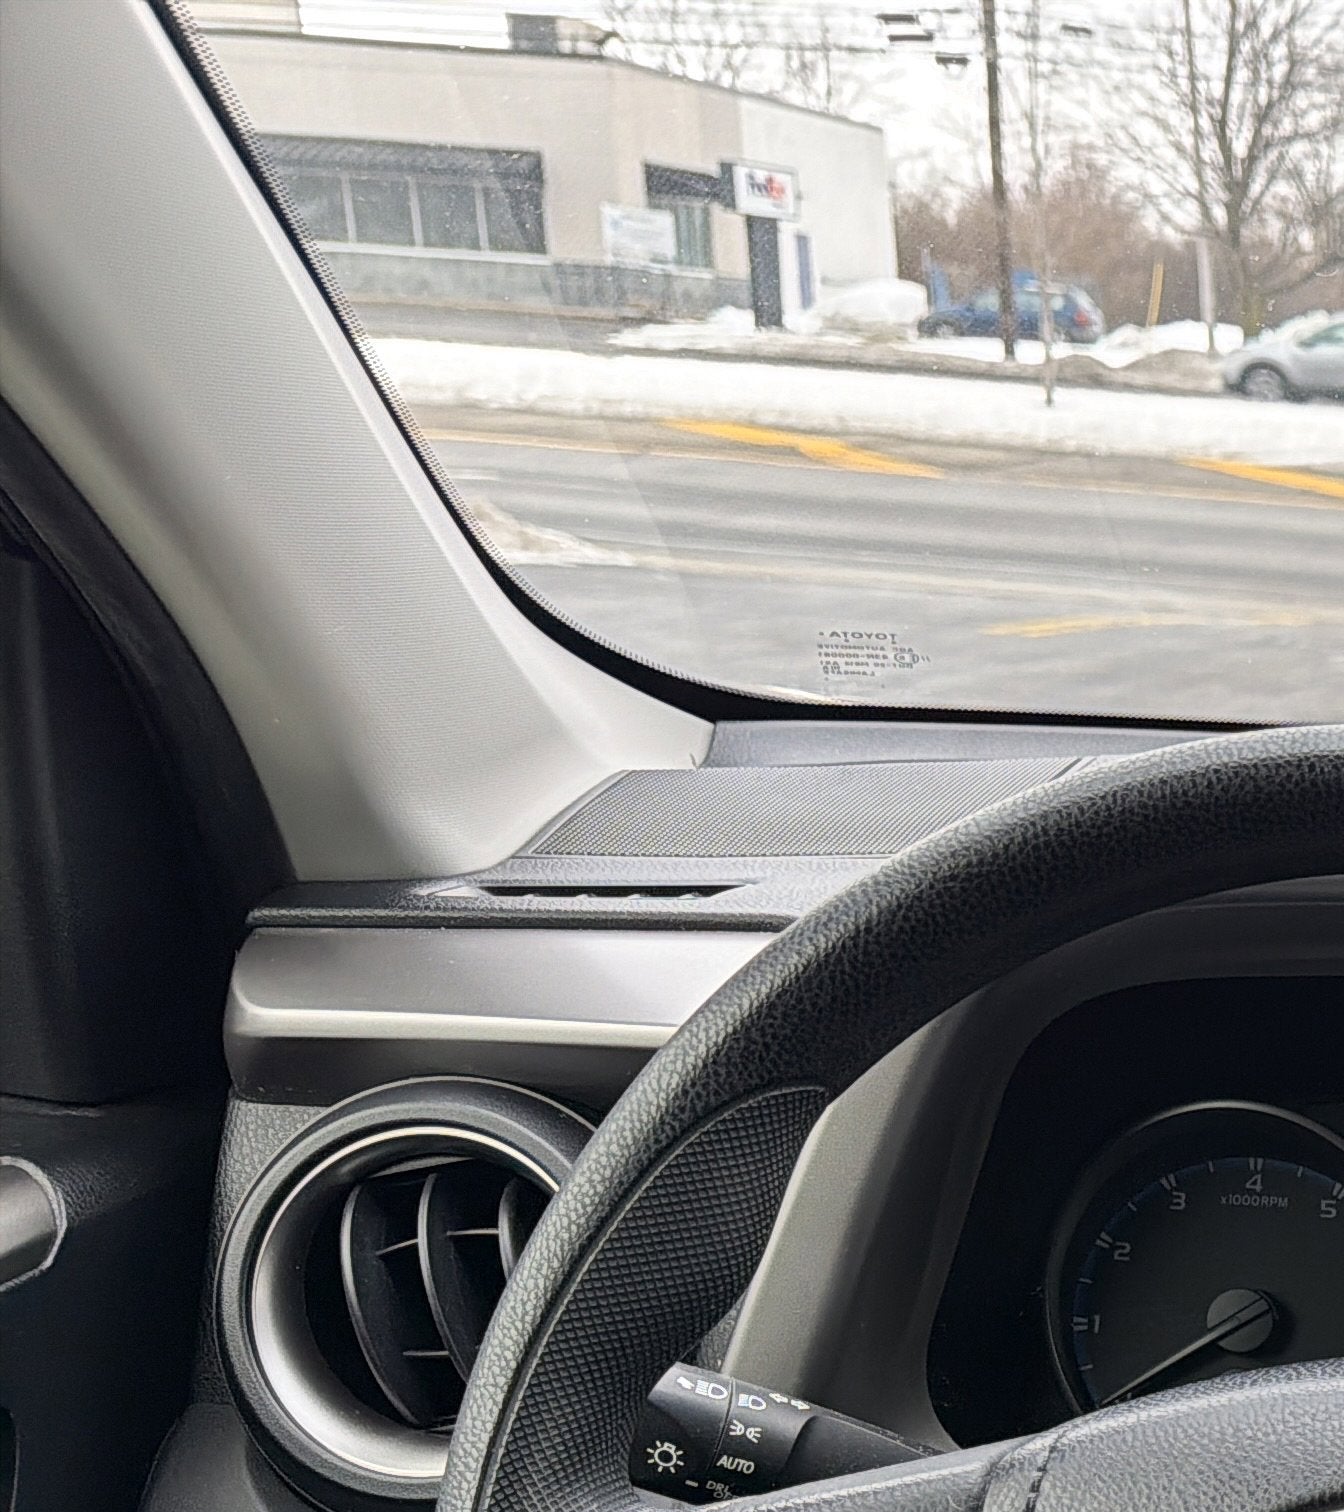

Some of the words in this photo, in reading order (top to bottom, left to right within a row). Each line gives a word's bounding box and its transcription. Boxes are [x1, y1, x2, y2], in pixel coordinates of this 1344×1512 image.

[1246, 1175, 1263, 1192] 4
[1170, 1192, 1186, 1210] 3
[1220, 1194, 1289, 1208] x1000RPM
[1320, 1200, 1337, 1219] 5
[1113, 1243, 1131, 1261] 2
[1093, 1315, 1101, 1334] 1
[716, 1454, 755, 1474] AUTO
